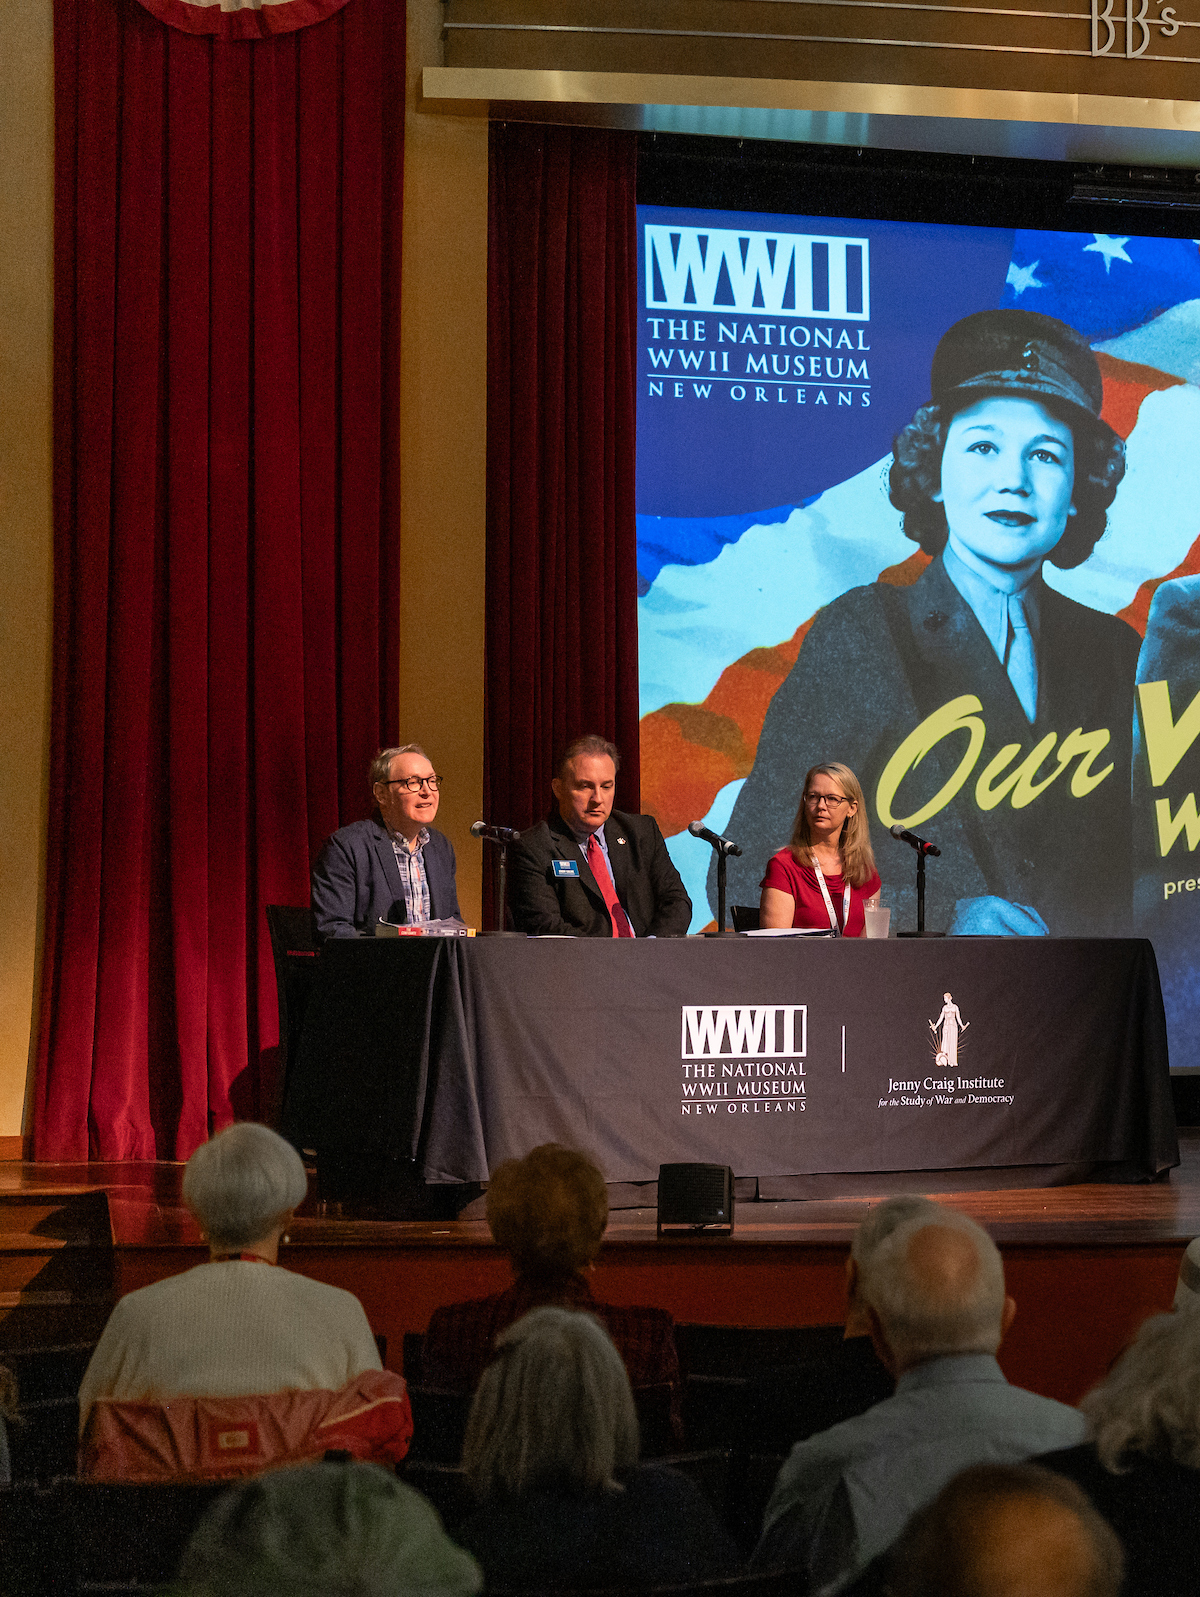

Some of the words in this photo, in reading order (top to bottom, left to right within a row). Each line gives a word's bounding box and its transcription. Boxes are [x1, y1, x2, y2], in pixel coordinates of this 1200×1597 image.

[646, 226, 866, 319] WWII
[646, 317, 707, 342] THE
[717, 321, 871, 351] NATIONAL
[647, 347, 730, 373] WWII
[745, 352, 870, 380] MUSEUM
[648, 381, 713, 399] NEW
[729, 385, 871, 408] ORLEANS
[875, 693, 1115, 830] Our
[683, 1005, 806, 1058] WWII
[682, 1063, 716, 1078] THE
[721, 1062, 807, 1077] NATIONAL
[682, 1082, 729, 1096] WWII
[736, 1080, 806, 1096] MUSEUM
[888, 1078, 921, 1093] Jenny
[923, 1076, 955, 1093] Craig
[957, 1076, 1005, 1090] Institute
[681, 1103, 718, 1115] NEW
[727, 1101, 806, 1114] ORLEANS
[878, 1097, 888, 1108] for
[889, 1097, 899, 1106] the
[900, 1095, 926, 1107] Study
[926, 1096, 934, 1106] of
[934, 1094, 954, 1105] War
[954, 1096, 967, 1104] and
[968, 1093, 1014, 1106] Democracy
